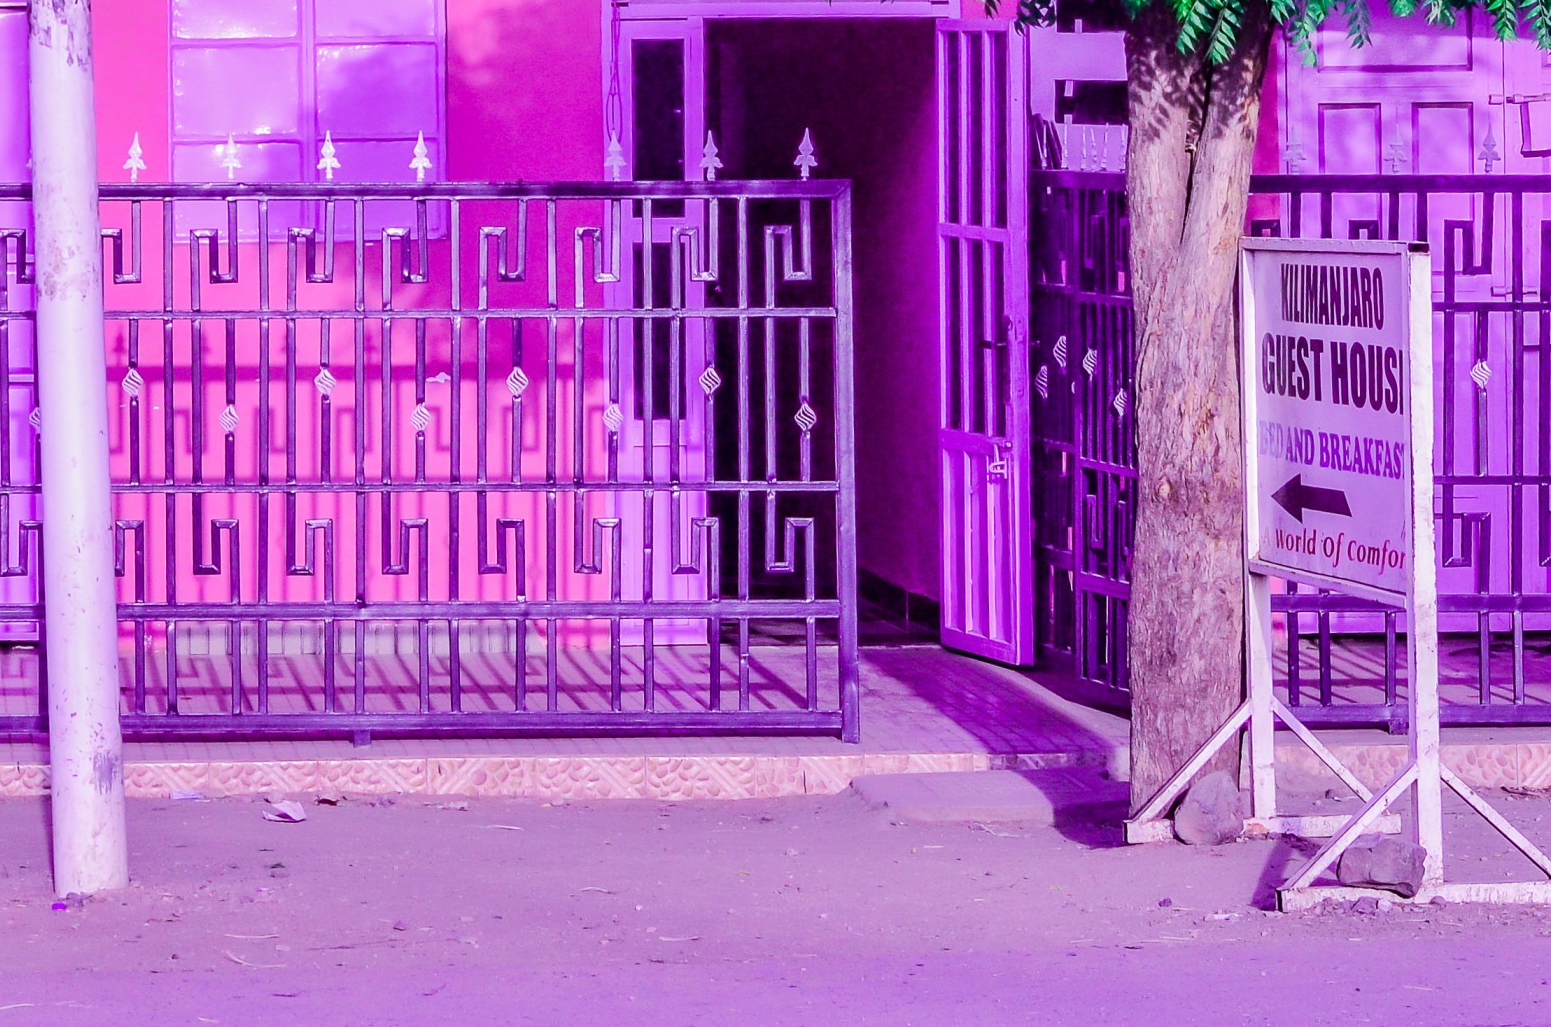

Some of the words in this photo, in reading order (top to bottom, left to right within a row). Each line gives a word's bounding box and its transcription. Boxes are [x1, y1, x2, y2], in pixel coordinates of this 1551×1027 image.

[1280, 263, 1384, 330] KILIMANJARO
[1261, 332, 1325, 403] GUEST
[1259, 420, 1284, 459] BED
[1286, 426, 1315, 466] AND
[1319, 431, 1405, 481] BREAKFAS
[1276, 527, 1317, 555] World
